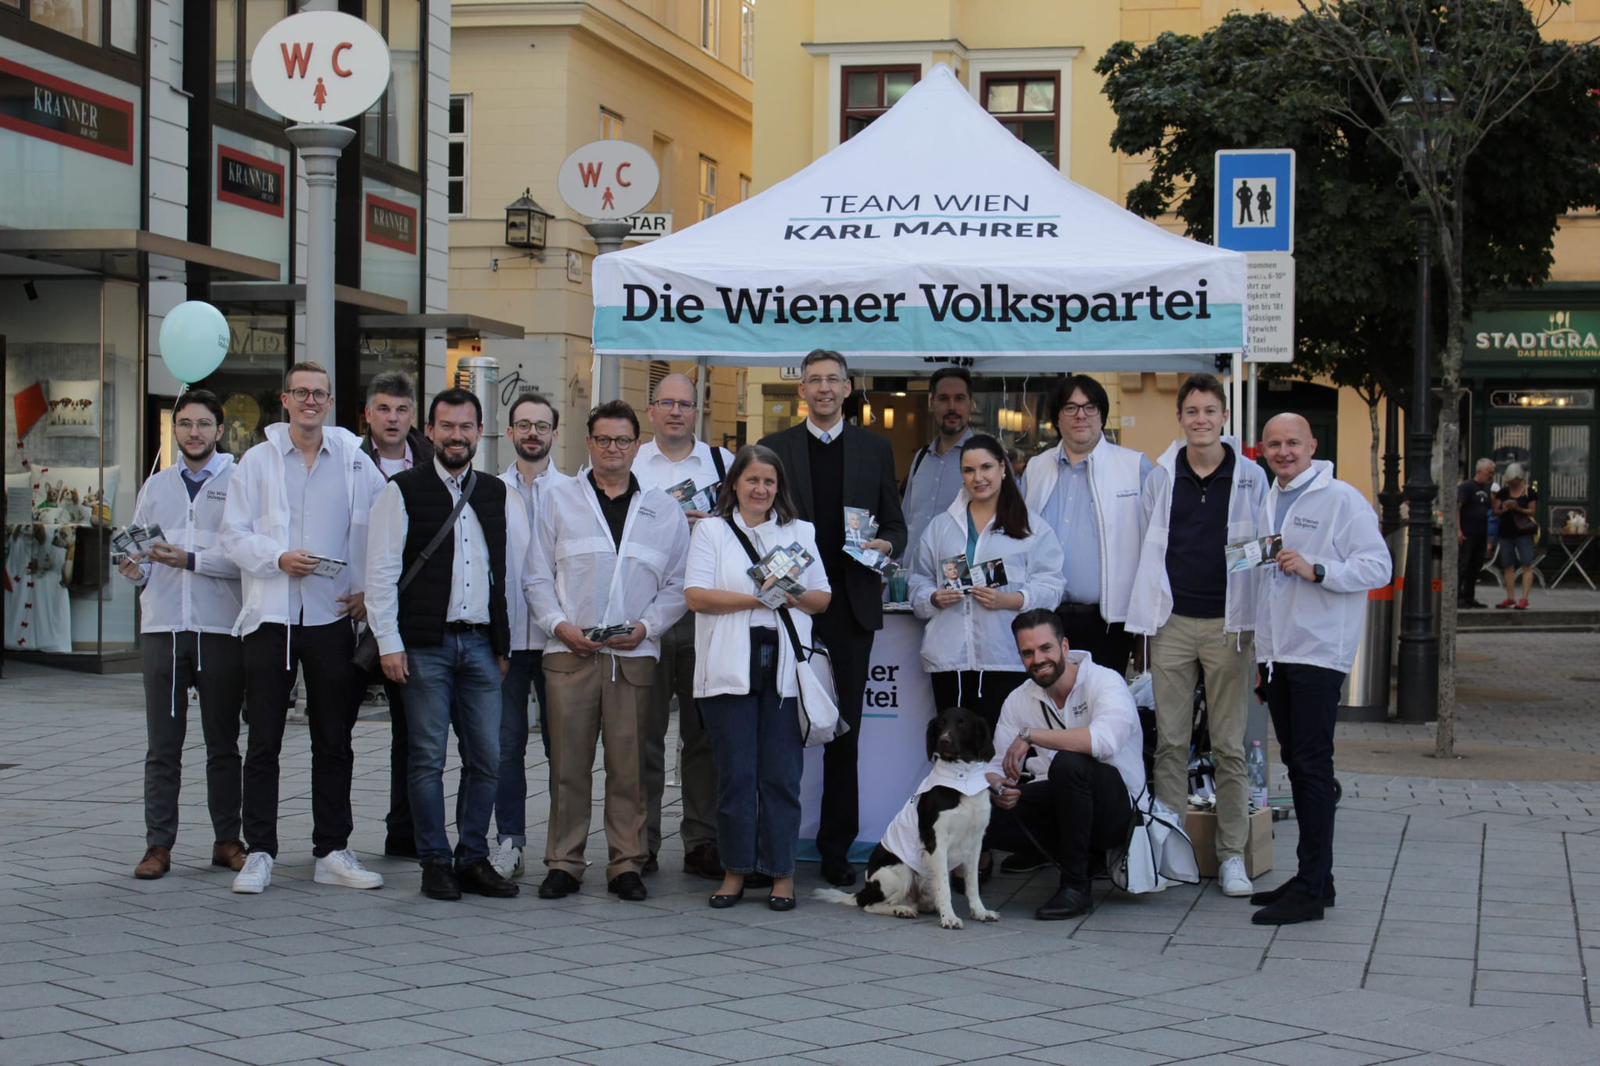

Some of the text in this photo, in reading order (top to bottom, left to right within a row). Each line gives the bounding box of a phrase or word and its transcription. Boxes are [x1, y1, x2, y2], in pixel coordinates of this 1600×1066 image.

[34, 86, 98, 129] KRANNER
[229, 161, 275, 193] KRANNER
[820, 194, 1029, 213] TEAM WIEN
[784, 221, 1060, 240] KARL MAHRER
[622, 278, 1211, 332] Die Wiener Volkspartei
[1475, 332, 1598, 349] STADTGRA
[866, 665, 899, 681] er
[865, 686, 898, 707] tei
